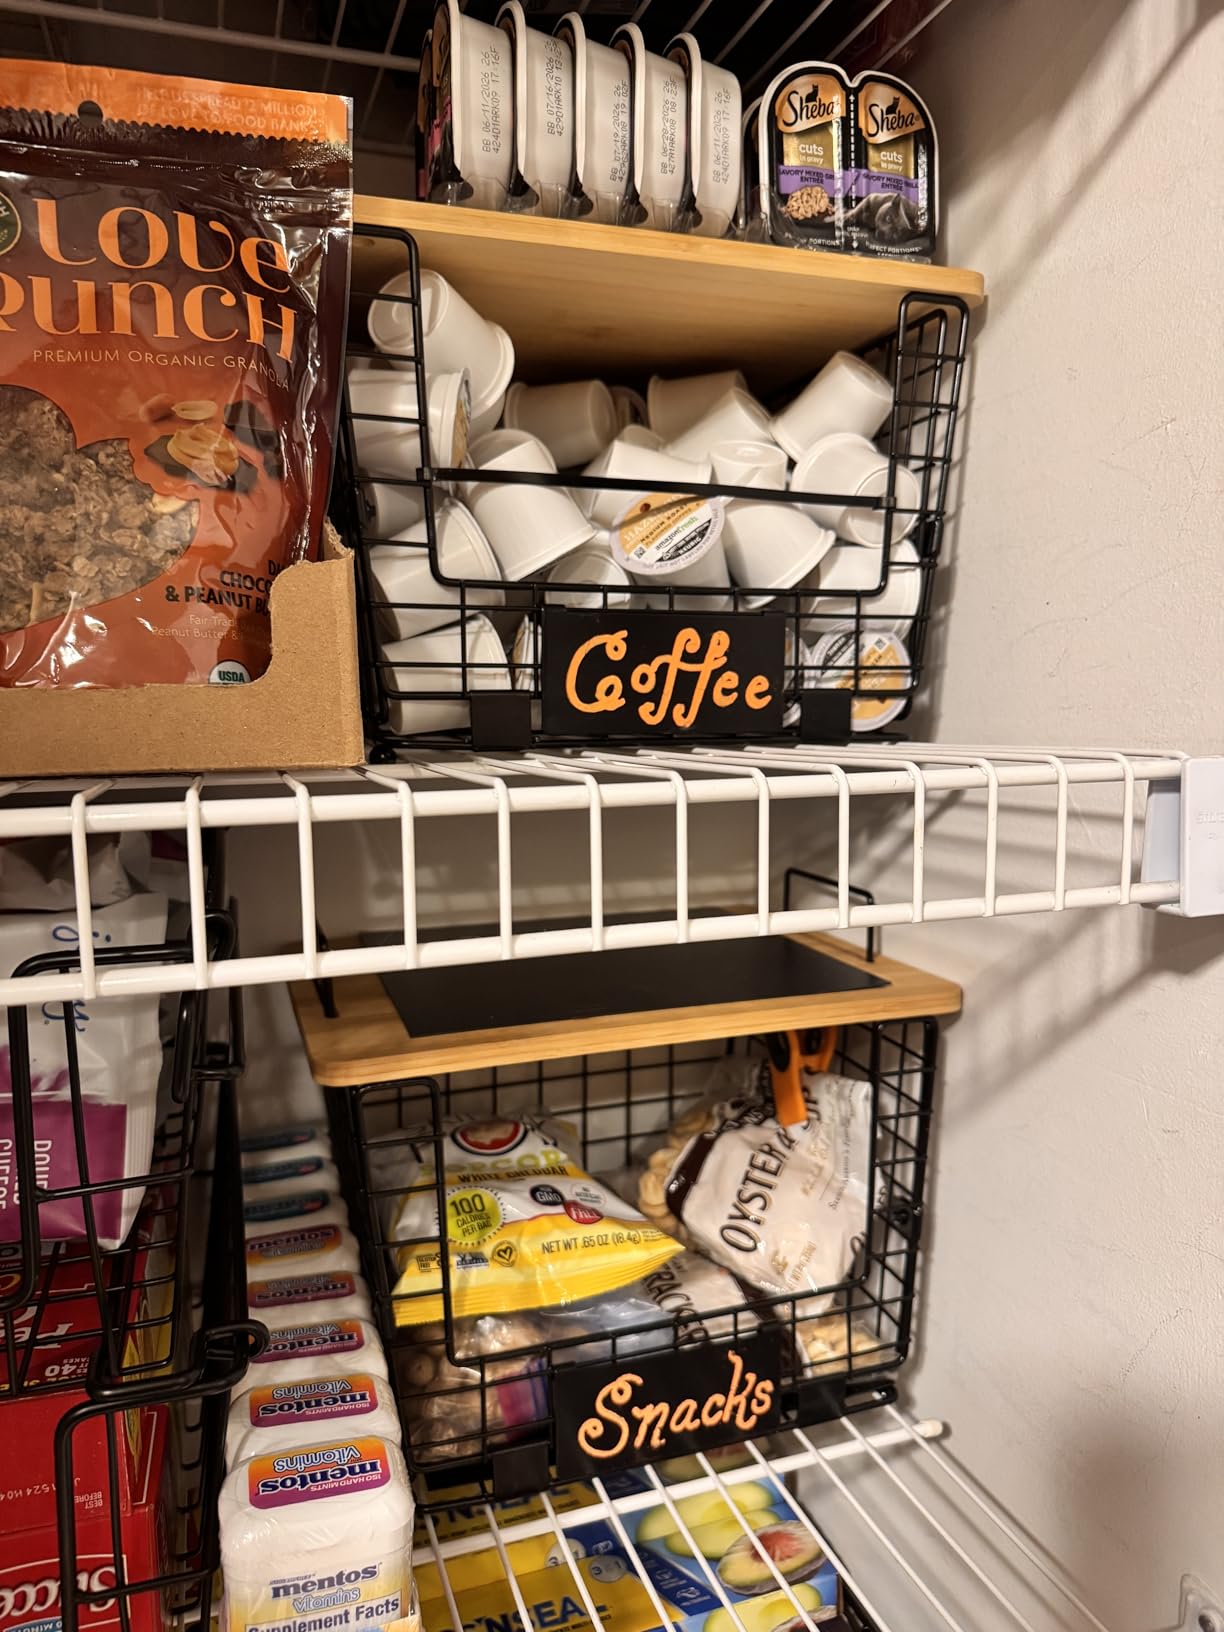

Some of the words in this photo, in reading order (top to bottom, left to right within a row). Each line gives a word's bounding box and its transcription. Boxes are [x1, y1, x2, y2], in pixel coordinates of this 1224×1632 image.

[546, 57, 554, 115] 07/16/2026
[481, 72, 491, 132] 06/11/2026
[783, 91, 835, 127] Sheba
[547, 122, 555, 135] BB
[867, 104, 915, 137] Sheba
[613, 104, 621, 161] 07/19/2026
[482, 139, 491, 152] BB
[799, 143, 824, 156] cuts
[880, 150, 903, 163] cuts
[610, 167, 618, 182] BB
[661, 162, 668, 174] BB
[713, 170, 721, 183] BB
[33, 350, 119, 363] PREMIUM
[127, 350, 216, 367] ORGANIC
[224, 357, 290, 391] GRANOLA
[221, 570, 273, 595] CHOCO
[165, 585, 180, 602] &
[184, 586, 252, 610] PEANUT
[189, 614, 209, 626] Fair
[211, 615, 238, 628] Trad
[153, 626, 190, 638] Peanut
[193, 630, 227, 640] Butter
[218, 670, 245, 682] USDA
[565, 627, 772, 729] Coffee
[451, 1193, 486, 1216] 100
[536, 1191, 562, 1202] GMO
[719, 1141, 788, 1253] OYSTER
[462, 1223, 478, 1237] PER
[541, 1240, 561, 1254] NET
[563, 1237, 578, 1251] WT
[581, 1235, 596, 1249] .65
[597, 1233, 609, 1246] OZ
[45, 1364, 77, 1376] 40
[273, 1379, 351, 1400] vitamins
[259, 1391, 369, 1416] mentos
[577, 1350, 775, 1459] Snacks
[273, 1445, 361, 1472] vitamins
[259, 1460, 382, 1495] mentos
[310, 1482, 339, 1492] MINTS
[340, 1477, 365, 1486] HARD
[73, 1491, 103, 1504] BEFORE
[84, 1500, 103, 1509] BEST
[271, 1565, 378, 1599] mentos
[293, 1587, 361, 1614] vitamins
[355, 1598, 400, 1621] Facts
